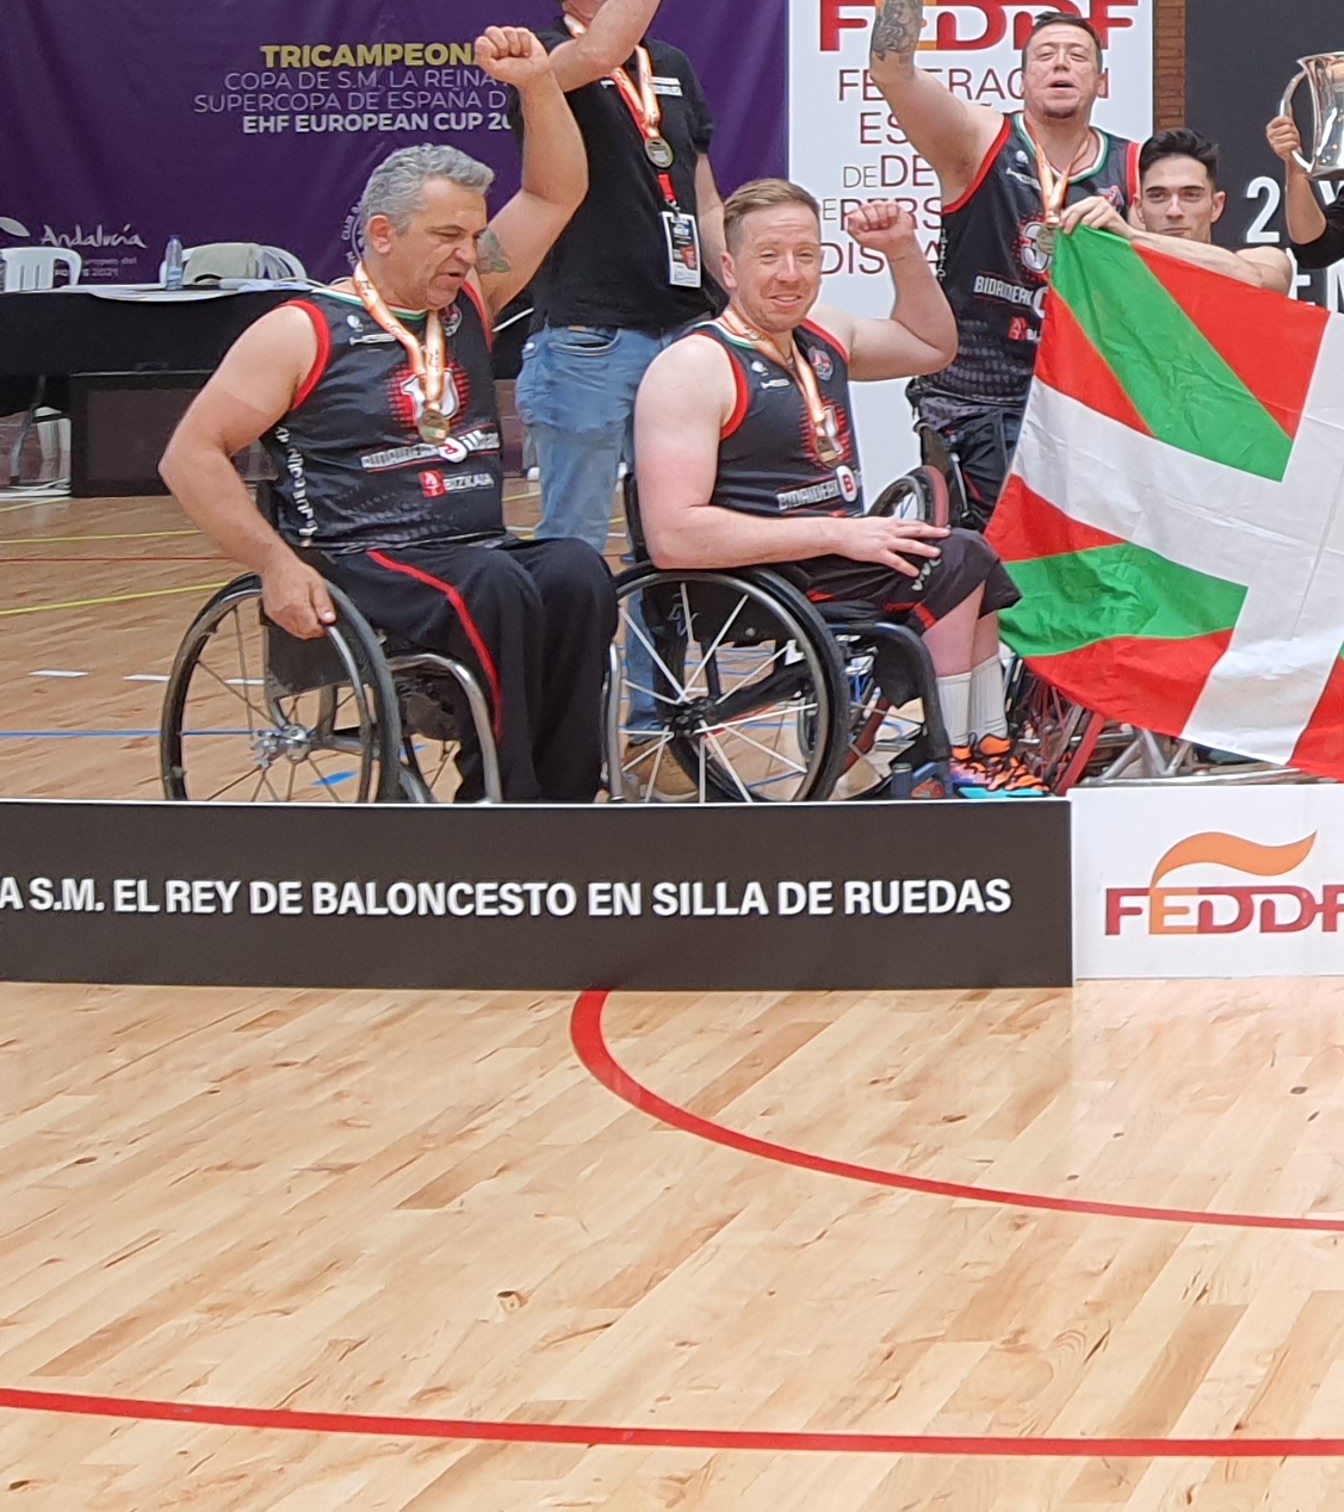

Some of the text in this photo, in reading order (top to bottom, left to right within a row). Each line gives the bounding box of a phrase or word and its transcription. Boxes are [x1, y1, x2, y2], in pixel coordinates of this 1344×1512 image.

[261, 43, 480, 68] TRICAMPEON
[224, 69, 495, 90] COPA DE S.M. LA REINA
[194, 87, 482, 113] SUPERCOPA DE ESPAÑA
[243, 115, 289, 134] EHF
[295, 113, 429, 133] EUROPEAN
[434, 112, 480, 131] CUP
[41, 224, 148, 248] Andalucía
[30, 877, 1011, 919] S.M. EL REY DE BALONCESTO EN SILLA DE RUEDAS
